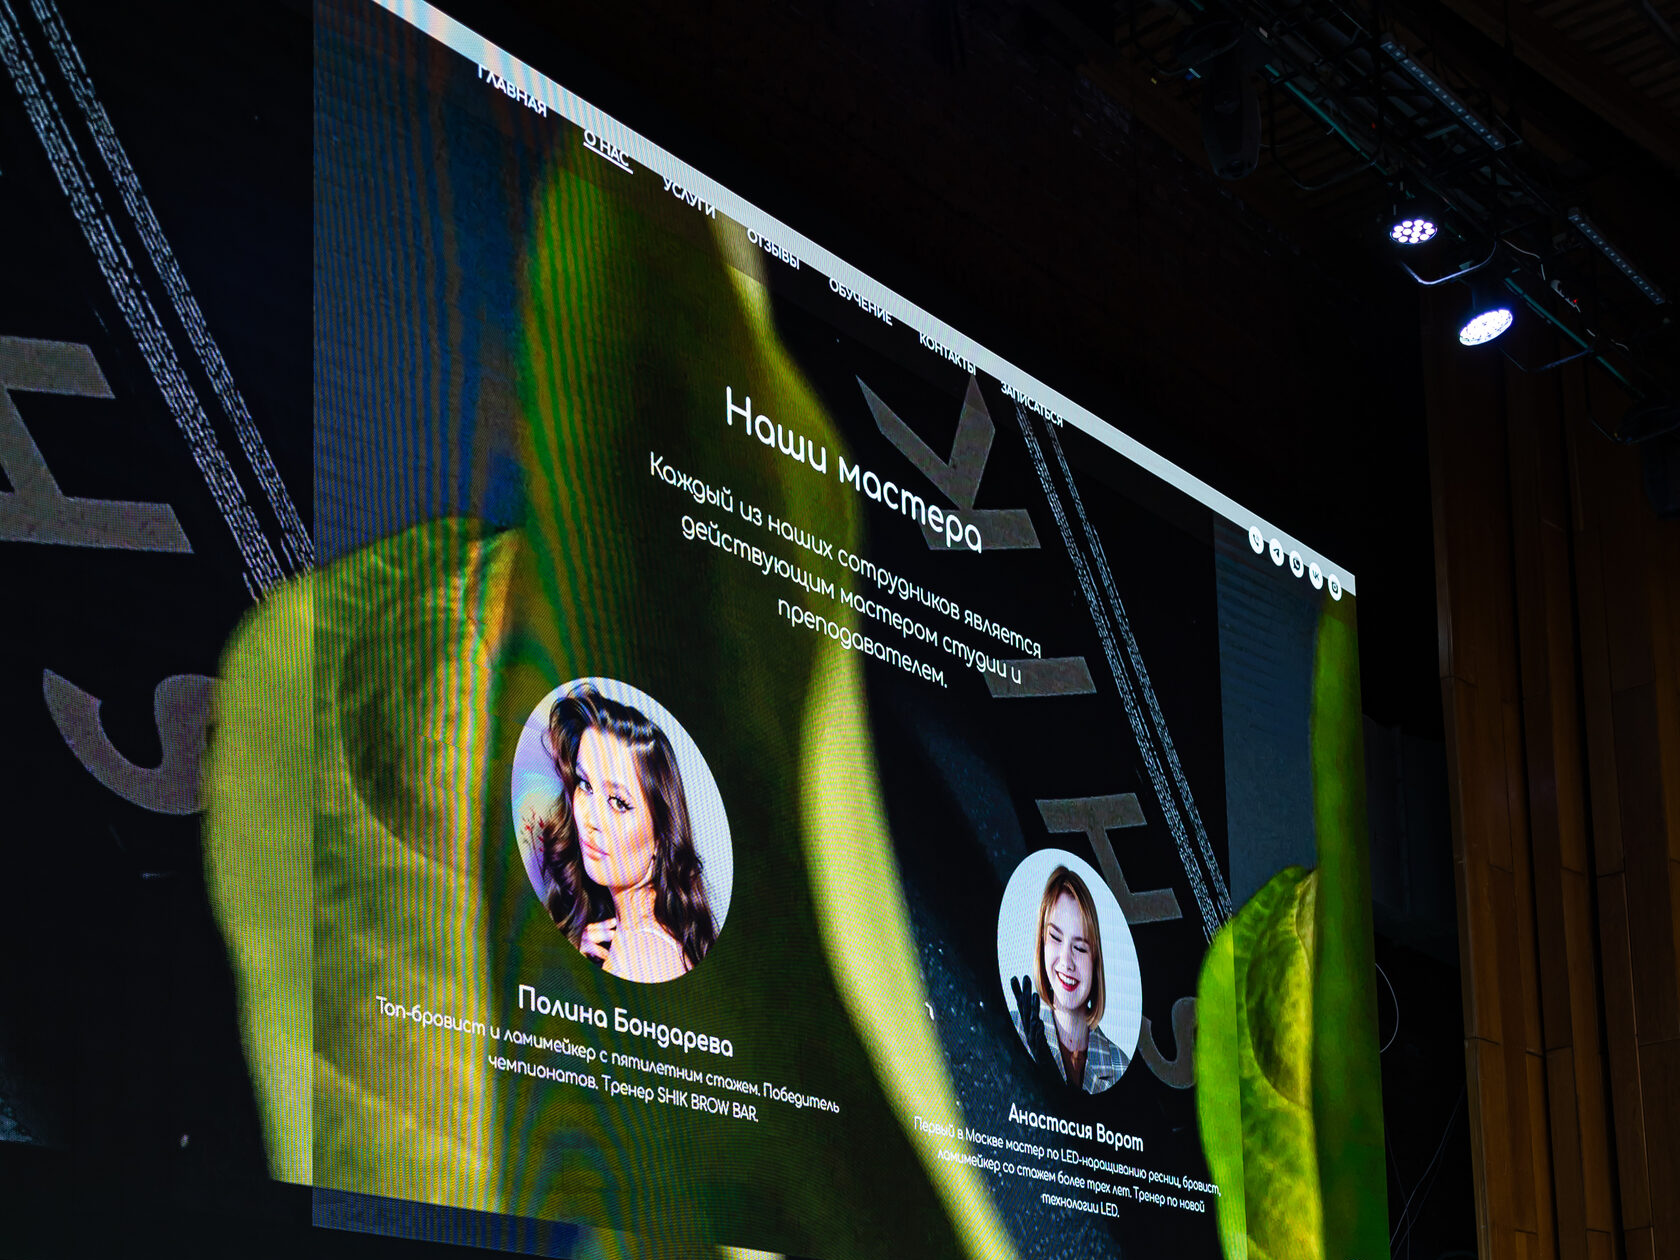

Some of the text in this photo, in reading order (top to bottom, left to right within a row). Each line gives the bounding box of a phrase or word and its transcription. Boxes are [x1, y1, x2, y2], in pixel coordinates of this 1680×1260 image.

[477, 63, 548, 118] ГЛАВНАЯ
[600, 135, 630, 167] НАС
[662, 175, 716, 219] УСЛУГИ
[747, 228, 800, 270] ОТЗЫВЫ
[829, 277, 893, 326] ОБУЧЕНИЕ
[919, 331, 977, 376] КОНТАКТЫ
[1000, 380, 1064, 428] ЗАПИСАТЬСЯ
[725, 386, 983, 555] Наши мастера
[650, 451, 1042, 660] Каждый из наших сотрудников является
[680, 514, 1022, 685] действующим мастером студии и
[778, 598, 948, 689] преподавателем.
[518, 984, 734, 1059] Полина Бондарева
[375, 995, 840, 1115] Топ-бровист и ламимейкер с пятилетним стажем. Победитель
[487, 1055, 759, 1122] чемпионатов. Тренер SHIK BROW BAR.
[913, 1115, 955, 1138] Первый
[957, 1130, 964, 1139] в
[965, 1127, 1004, 1149] Москве
[1005, 1139, 1045, 1160] мастер
[1047, 1148, 1059, 1161] по
[1061, 1148, 1147, 1180] LED-наращиванию
[1182, 1175, 1222, 1197] бровист,
[1007, 1102, 1144, 1152] Анастасия Ворот
[937, 1149, 1205, 1213] ламимейкер со стажем более трех лет. Тренер по новой
[1041, 1193, 1120, 1219] технологии LED.
